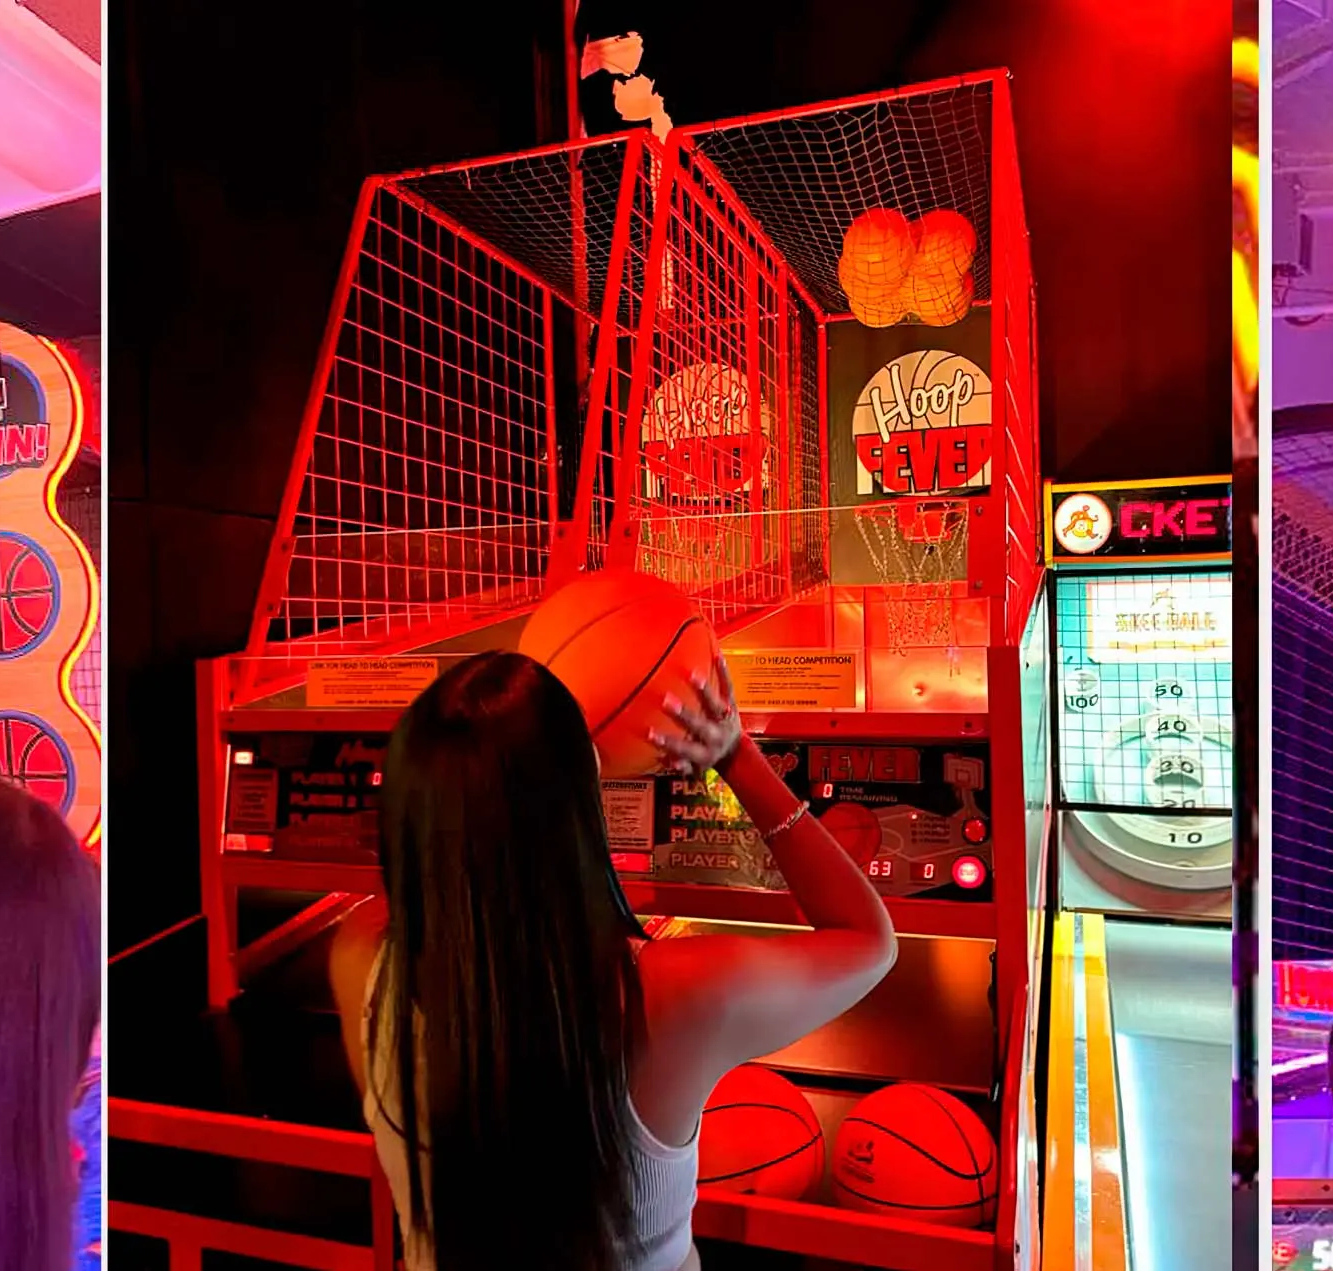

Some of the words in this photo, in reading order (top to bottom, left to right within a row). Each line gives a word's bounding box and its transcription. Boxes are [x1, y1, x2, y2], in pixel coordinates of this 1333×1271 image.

[870, 364, 975, 443] Hoop
[793, 656, 851, 665] COMPETITION
[1155, 684, 1183, 698] 50
[1070, 694, 1099, 709] 100
[1157, 720, 1187, 733] 40
[810, 747, 920, 781] FEVER
[372, 772, 382, 786] 0
[822, 783, 833, 798] 0
[1169, 832, 1203, 844] 10
[869, 861, 892, 877] 63
[924, 863, 935, 878] 0
